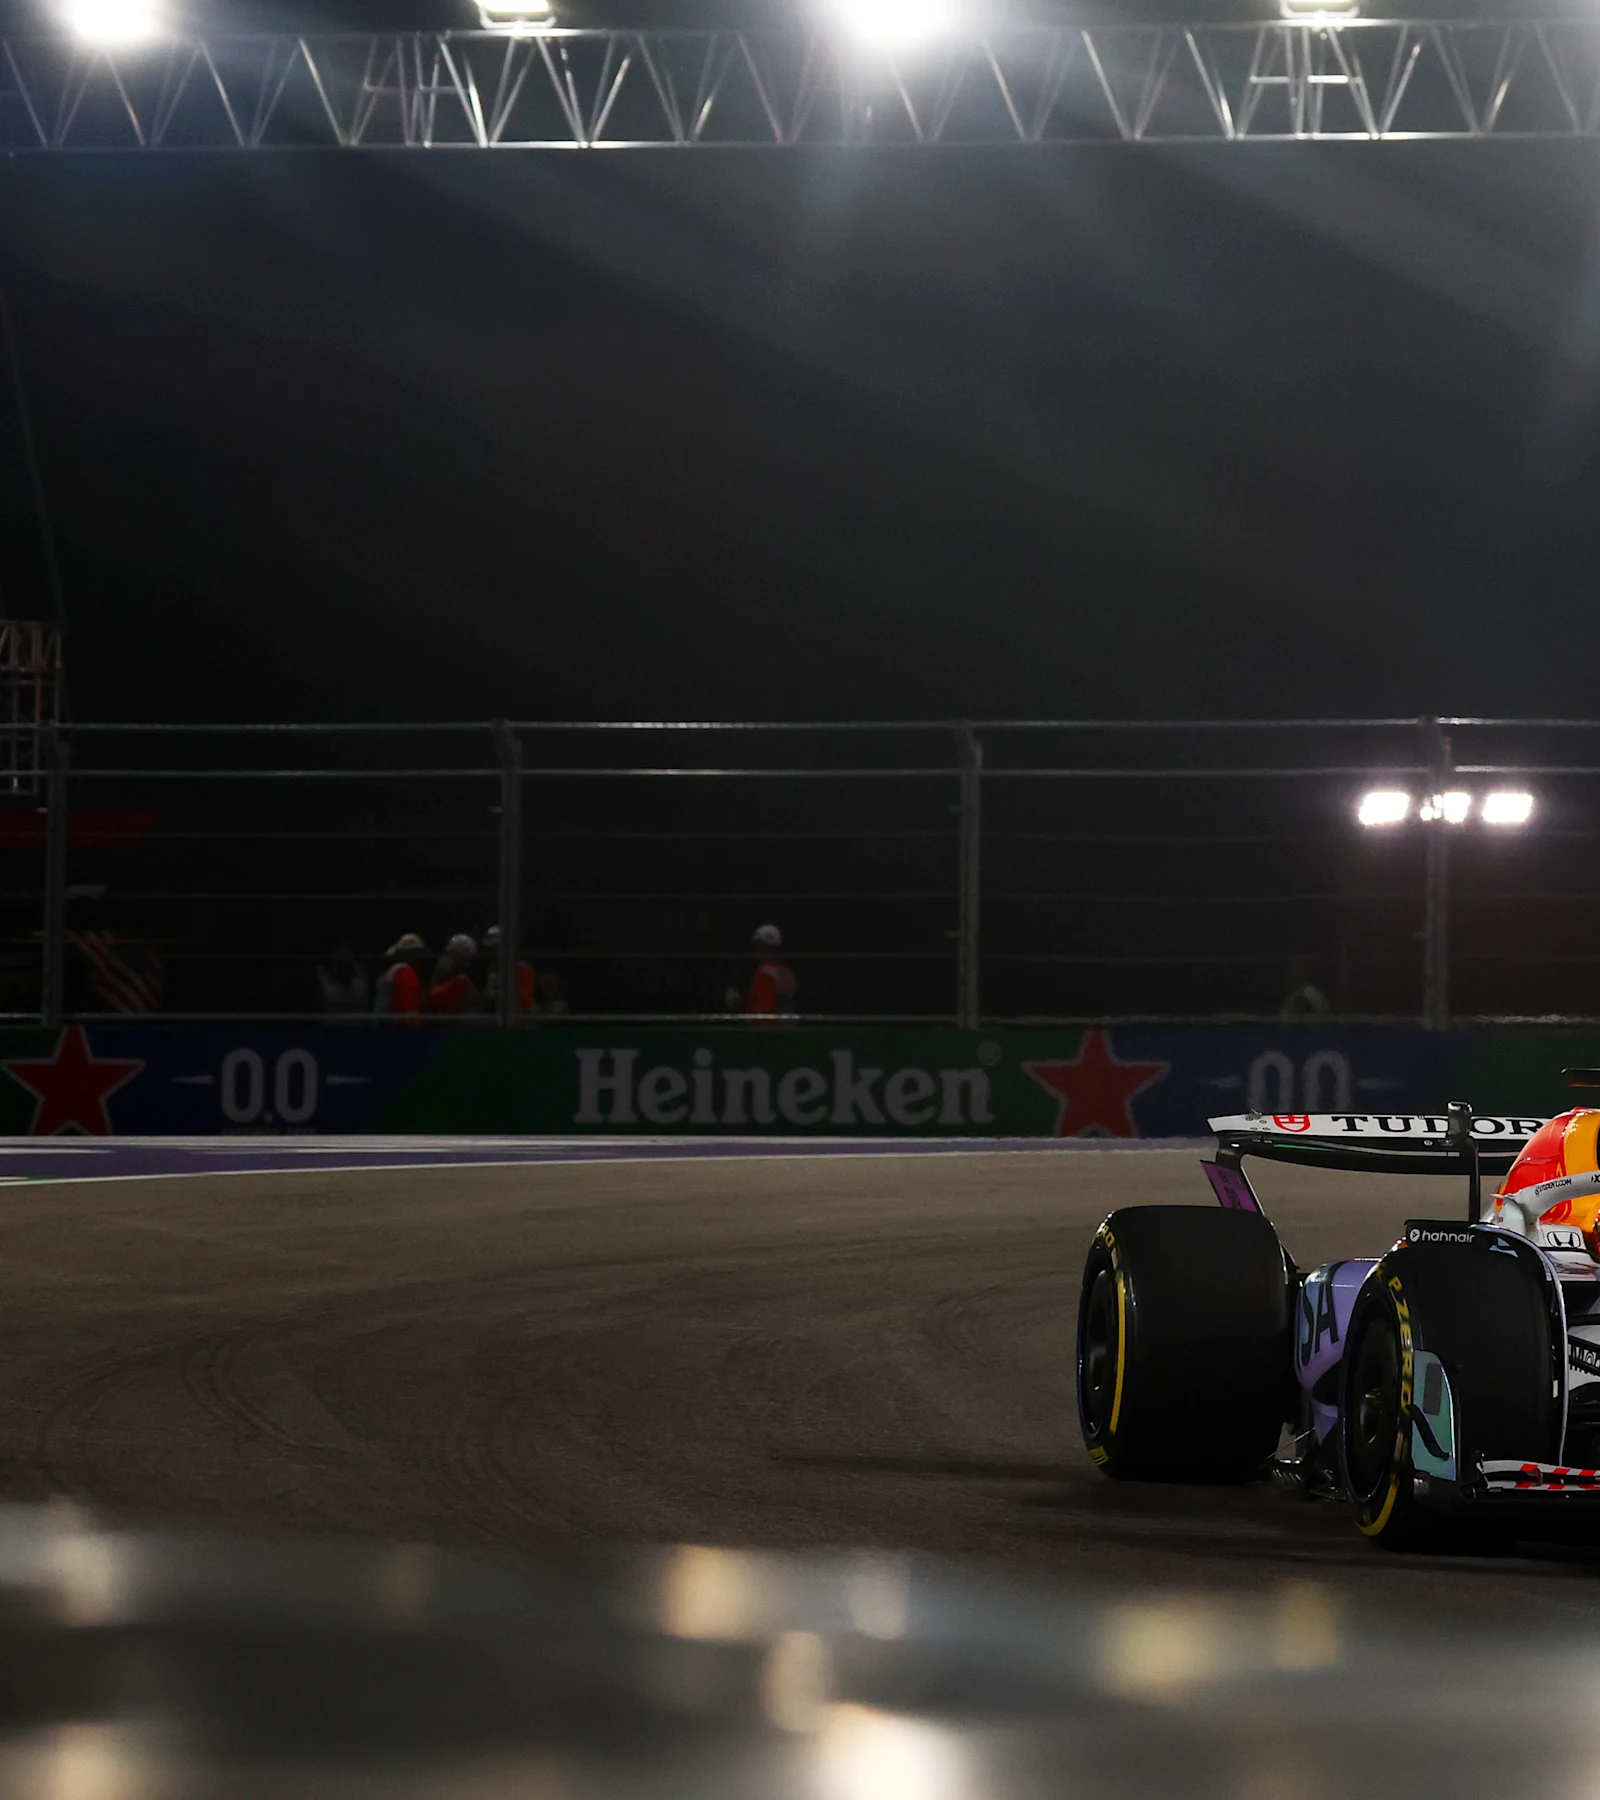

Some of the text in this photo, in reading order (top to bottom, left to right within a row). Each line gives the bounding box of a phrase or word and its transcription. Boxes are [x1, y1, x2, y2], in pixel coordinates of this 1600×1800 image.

[221, 1048, 319, 1124] 0.0
[574, 1048, 994, 1126] Heineken
[1331, 1115, 1546, 1136] TUDOR
[1421, 1229, 1476, 1243] hahnair
[1300, 1260, 1341, 1366] SA
